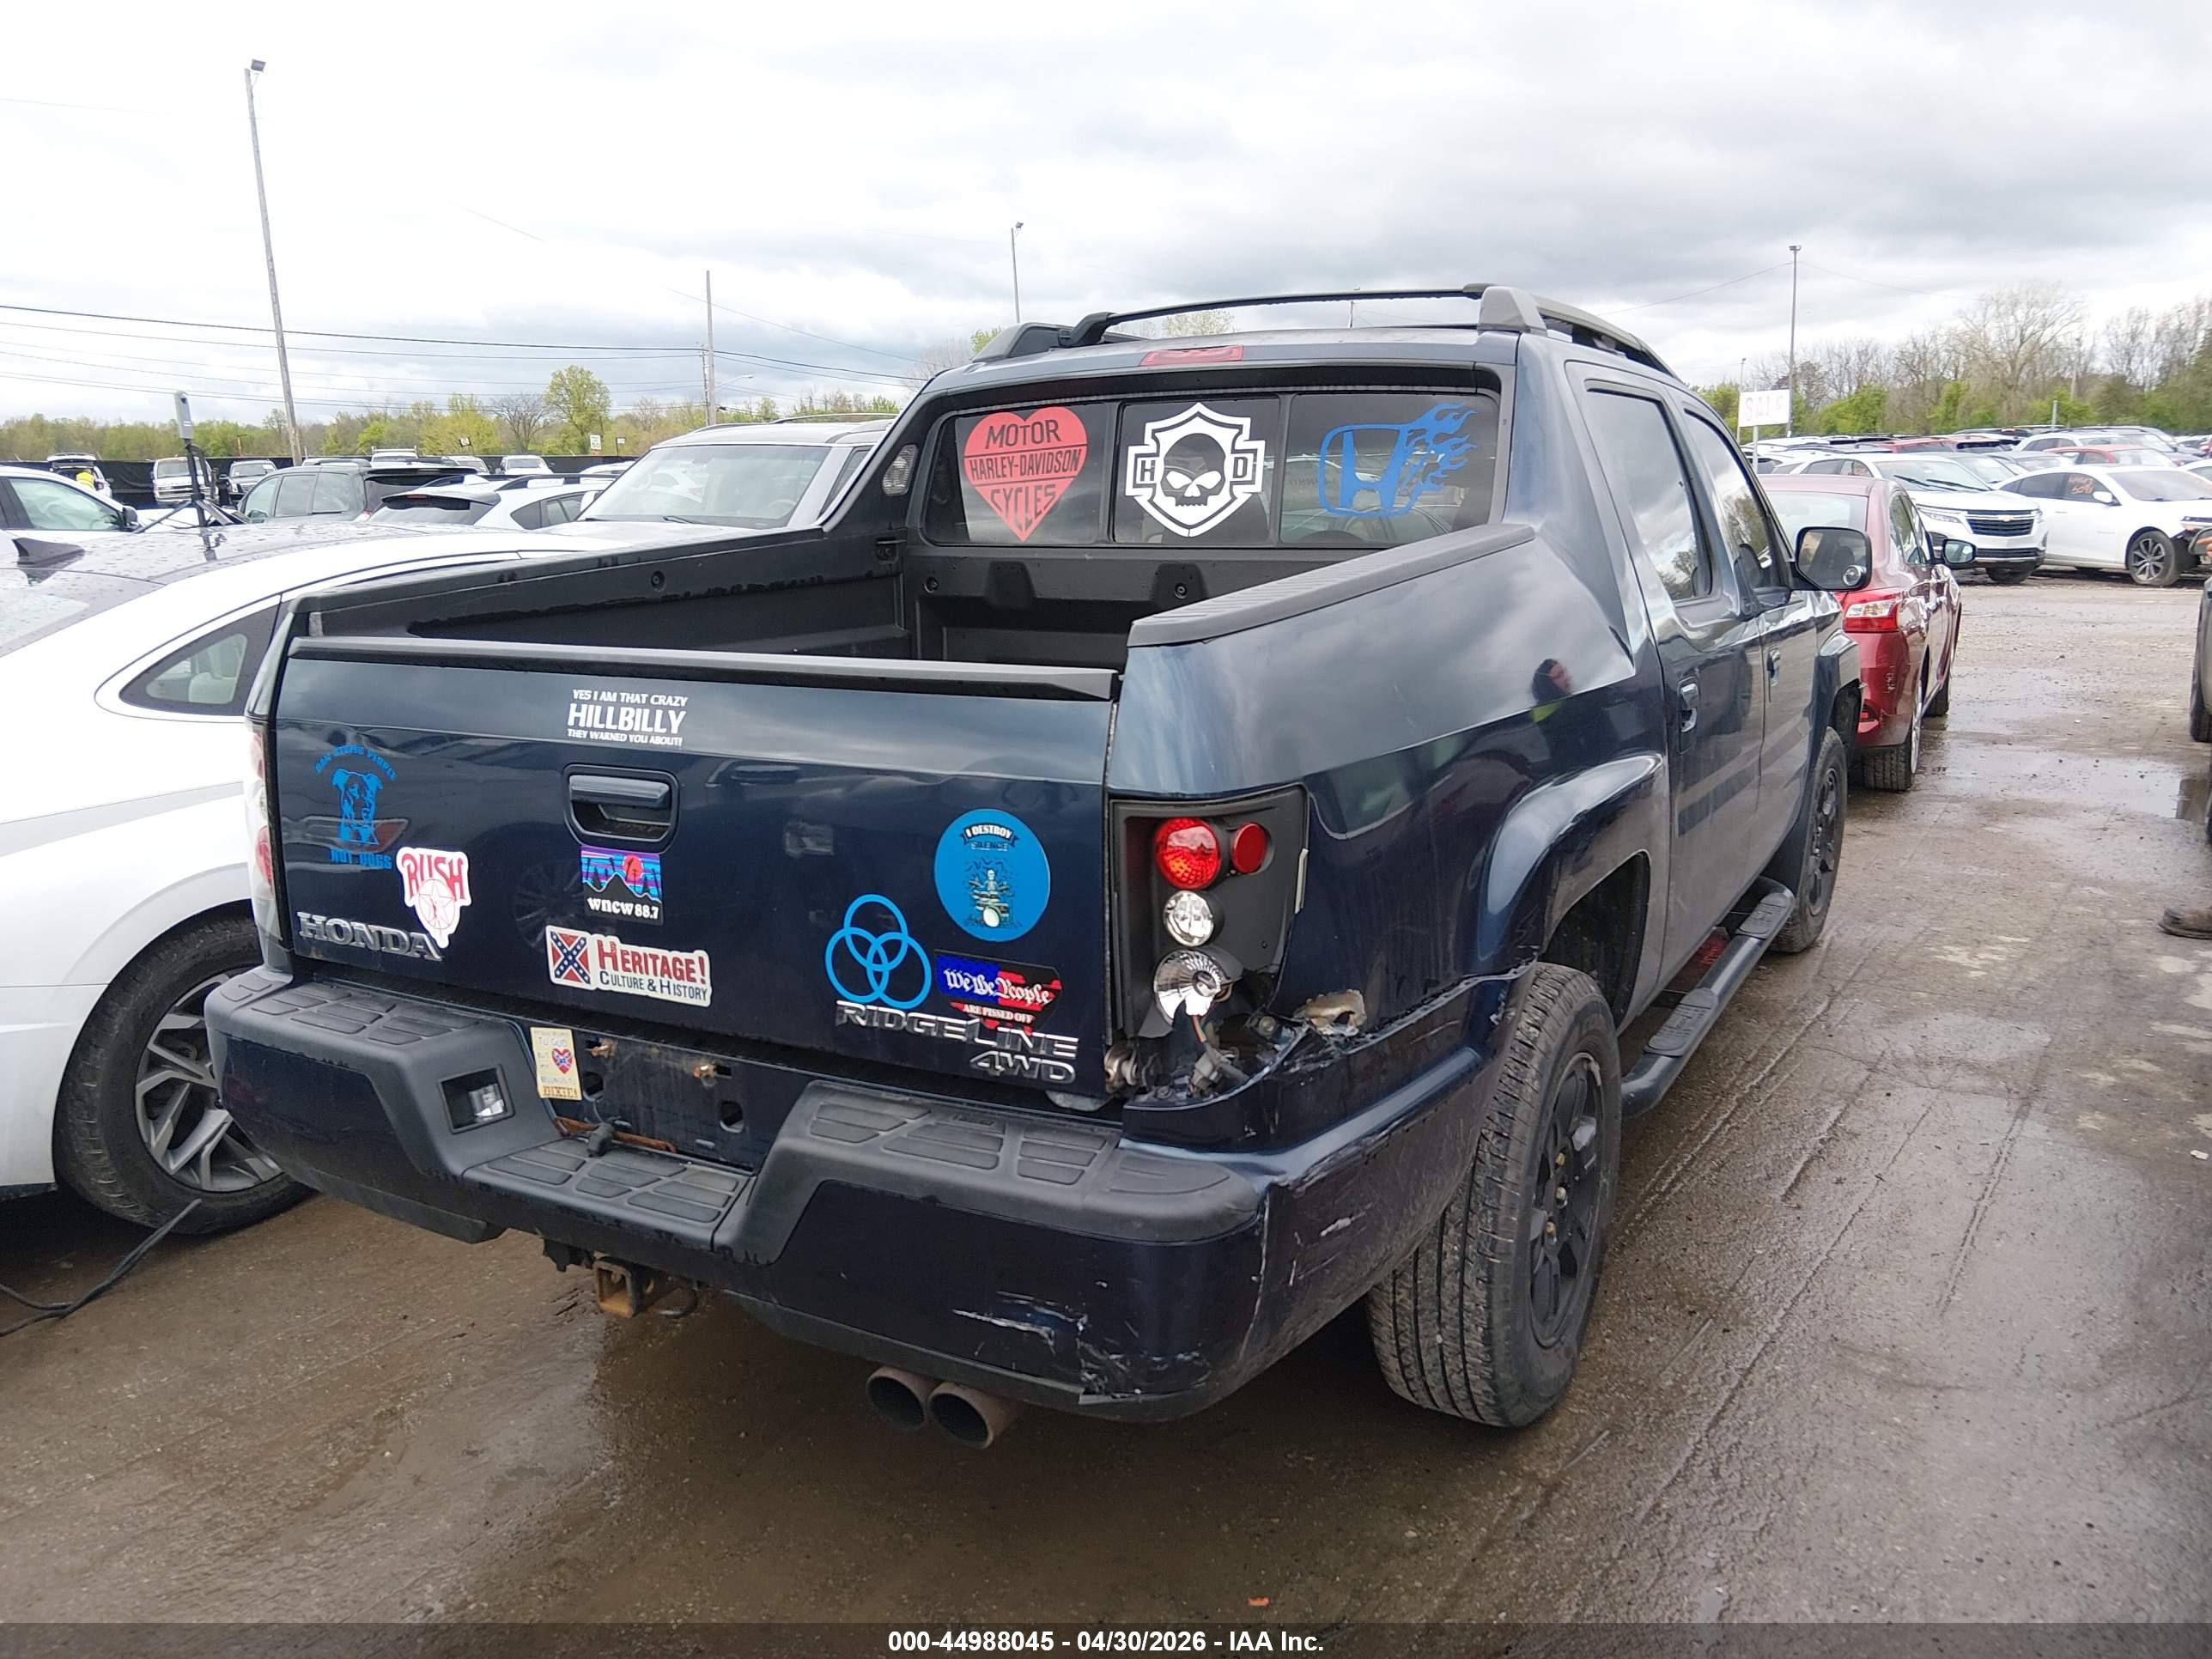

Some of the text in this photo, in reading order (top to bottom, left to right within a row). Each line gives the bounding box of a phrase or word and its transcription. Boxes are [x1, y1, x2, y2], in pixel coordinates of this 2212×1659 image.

[985, 419, 1061, 450] MOTOR
[969, 448, 1082, 482] HARLEY-DAVIDSON
[1139, 456, 1248, 482] H D
[990, 484, 1056, 532] CYCLES
[573, 689, 689, 707] YES I AM THAT CRAZY
[567, 702, 687, 734] HILLBILLY
[568, 729, 683, 746] THEY WARNED YOU ABOUT!
[965, 823, 1013, 839] I DESTROY
[358, 851, 392, 869] DOGS
[401, 853, 465, 901] RUSH
[634, 903, 659, 920] 88.7
[297, 911, 443, 962] HONDA
[597, 939, 706, 985] HERITAGE!
[599, 970, 708, 1001] CULTURE & HISTORY
[944, 968, 972, 992] We
[993, 976, 1054, 1006] People
[835, 1000, 1079, 1058] RIDGELINE
[963, 1004, 1036, 1024] ARE PISSED OFF
[969, 1050, 1075, 1085] 4WD
